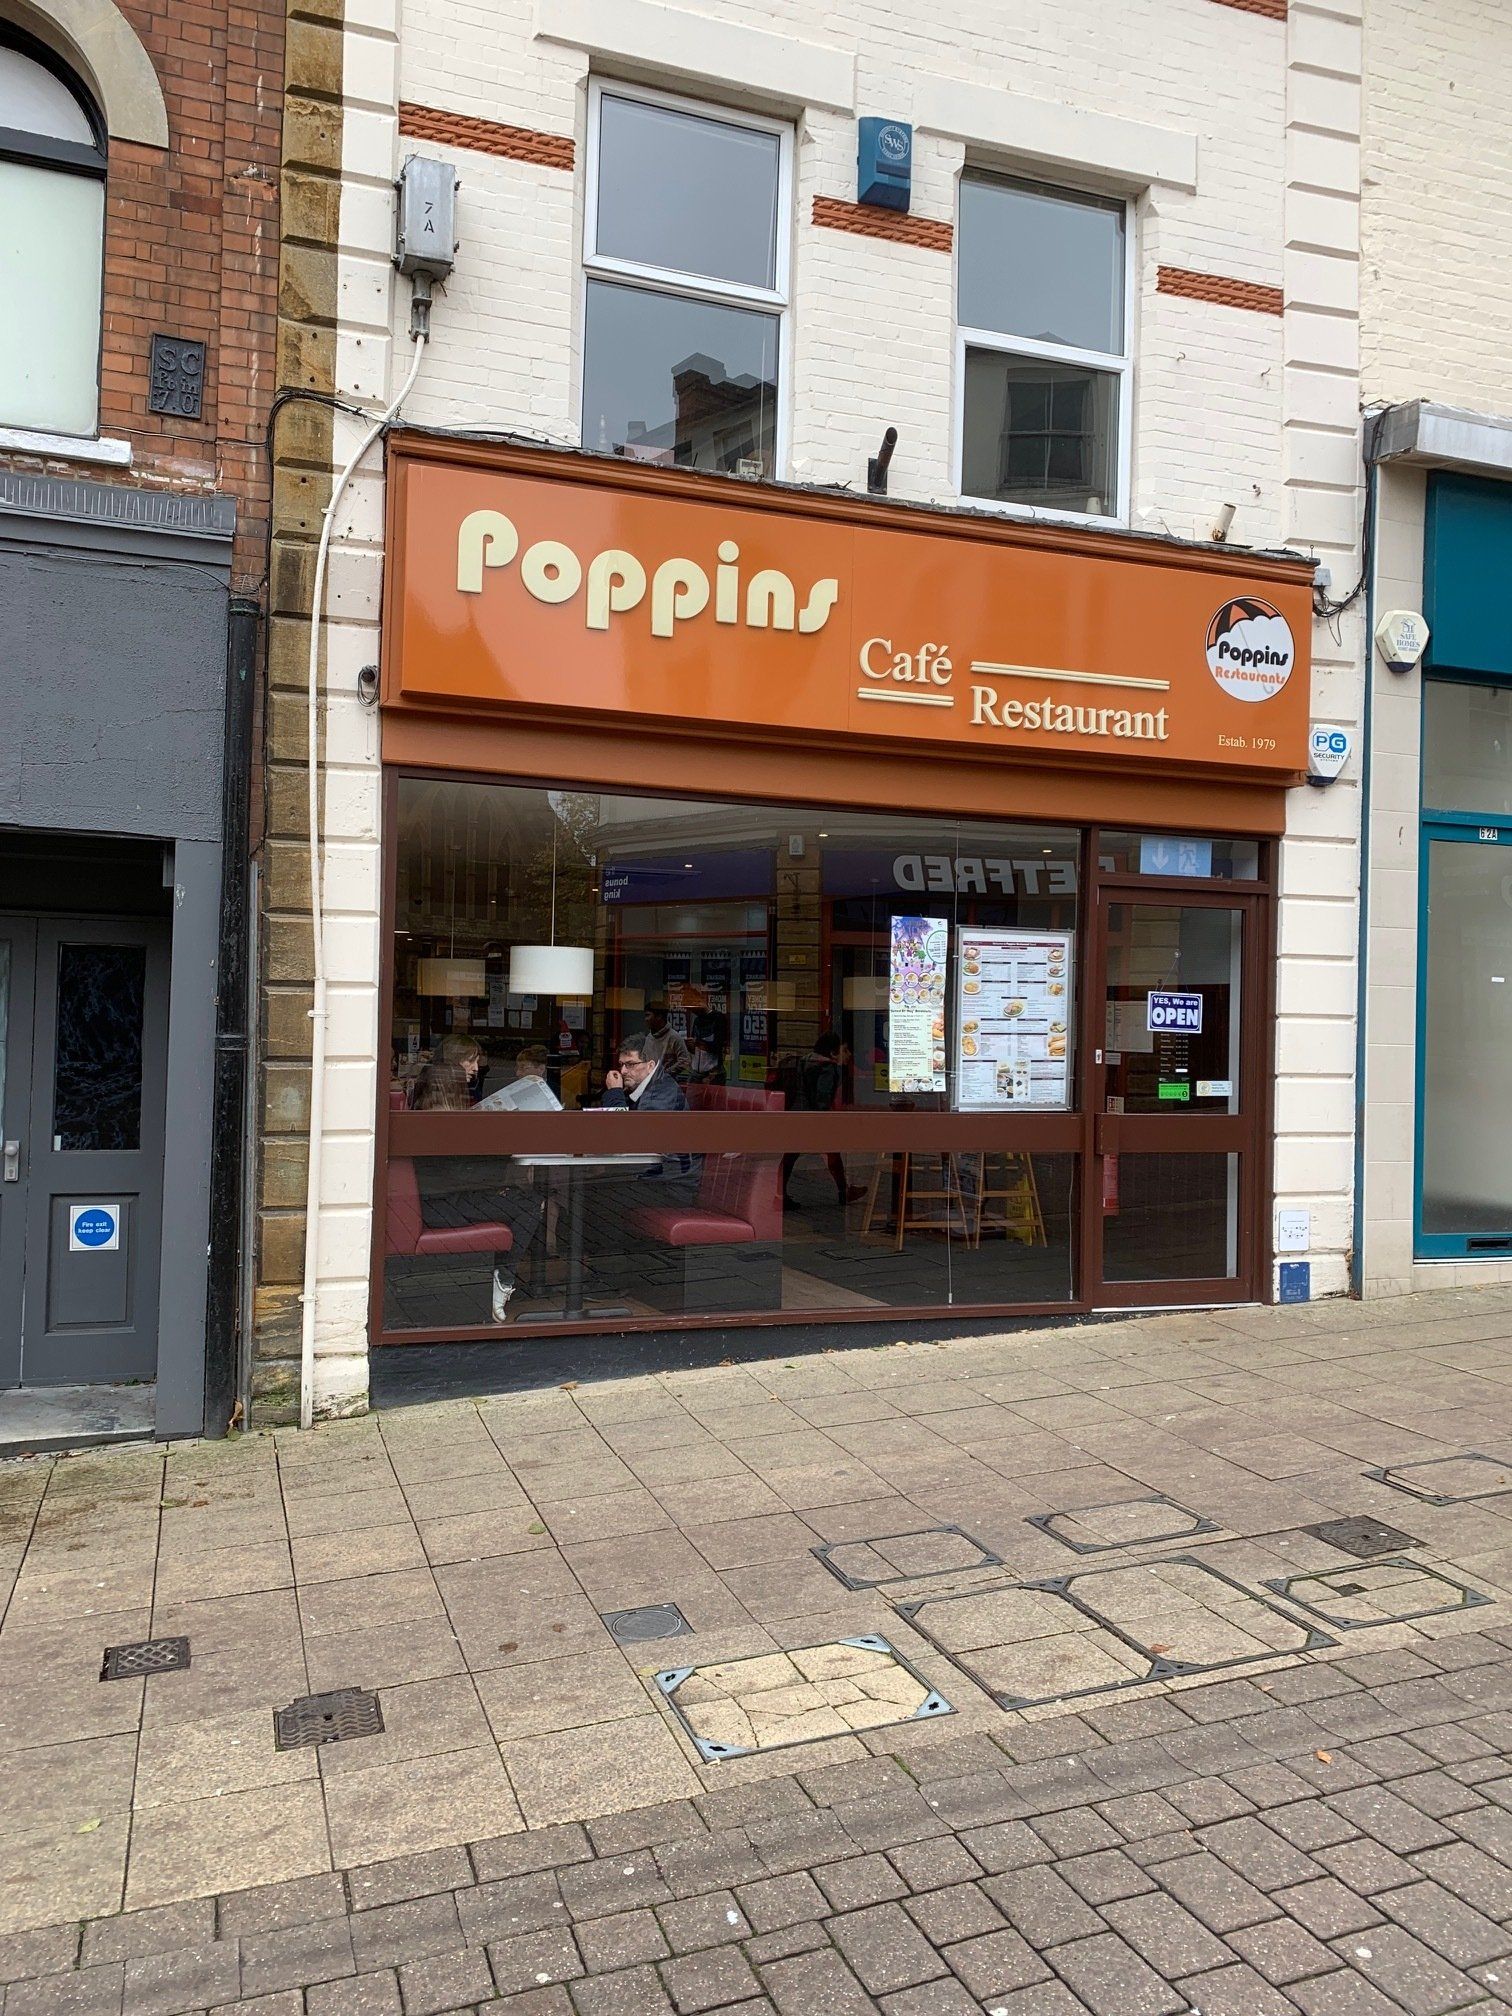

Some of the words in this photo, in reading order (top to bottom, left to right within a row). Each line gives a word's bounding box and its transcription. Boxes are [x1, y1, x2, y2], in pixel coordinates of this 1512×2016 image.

[884, 133, 905, 152] SWS
[424, 201, 434, 214] 7
[423, 219, 435, 233] A
[456, 509, 839, 638] Poppins
[858, 636, 954, 686] Café
[1218, 640, 1289, 668] Poppins
[1214, 665, 1286, 685] Restaurants
[970, 685, 1170, 742] Restaurant
[1217, 734, 1248, 749] Estab.
[1251, 737, 1276, 751] 1979
[1315, 734, 1345, 750] PG
[1313, 752, 1345, 760] SECURITY
[1153, 996, 1171, 1006] YES,
[1152, 1006, 1199, 1026] OPEN
